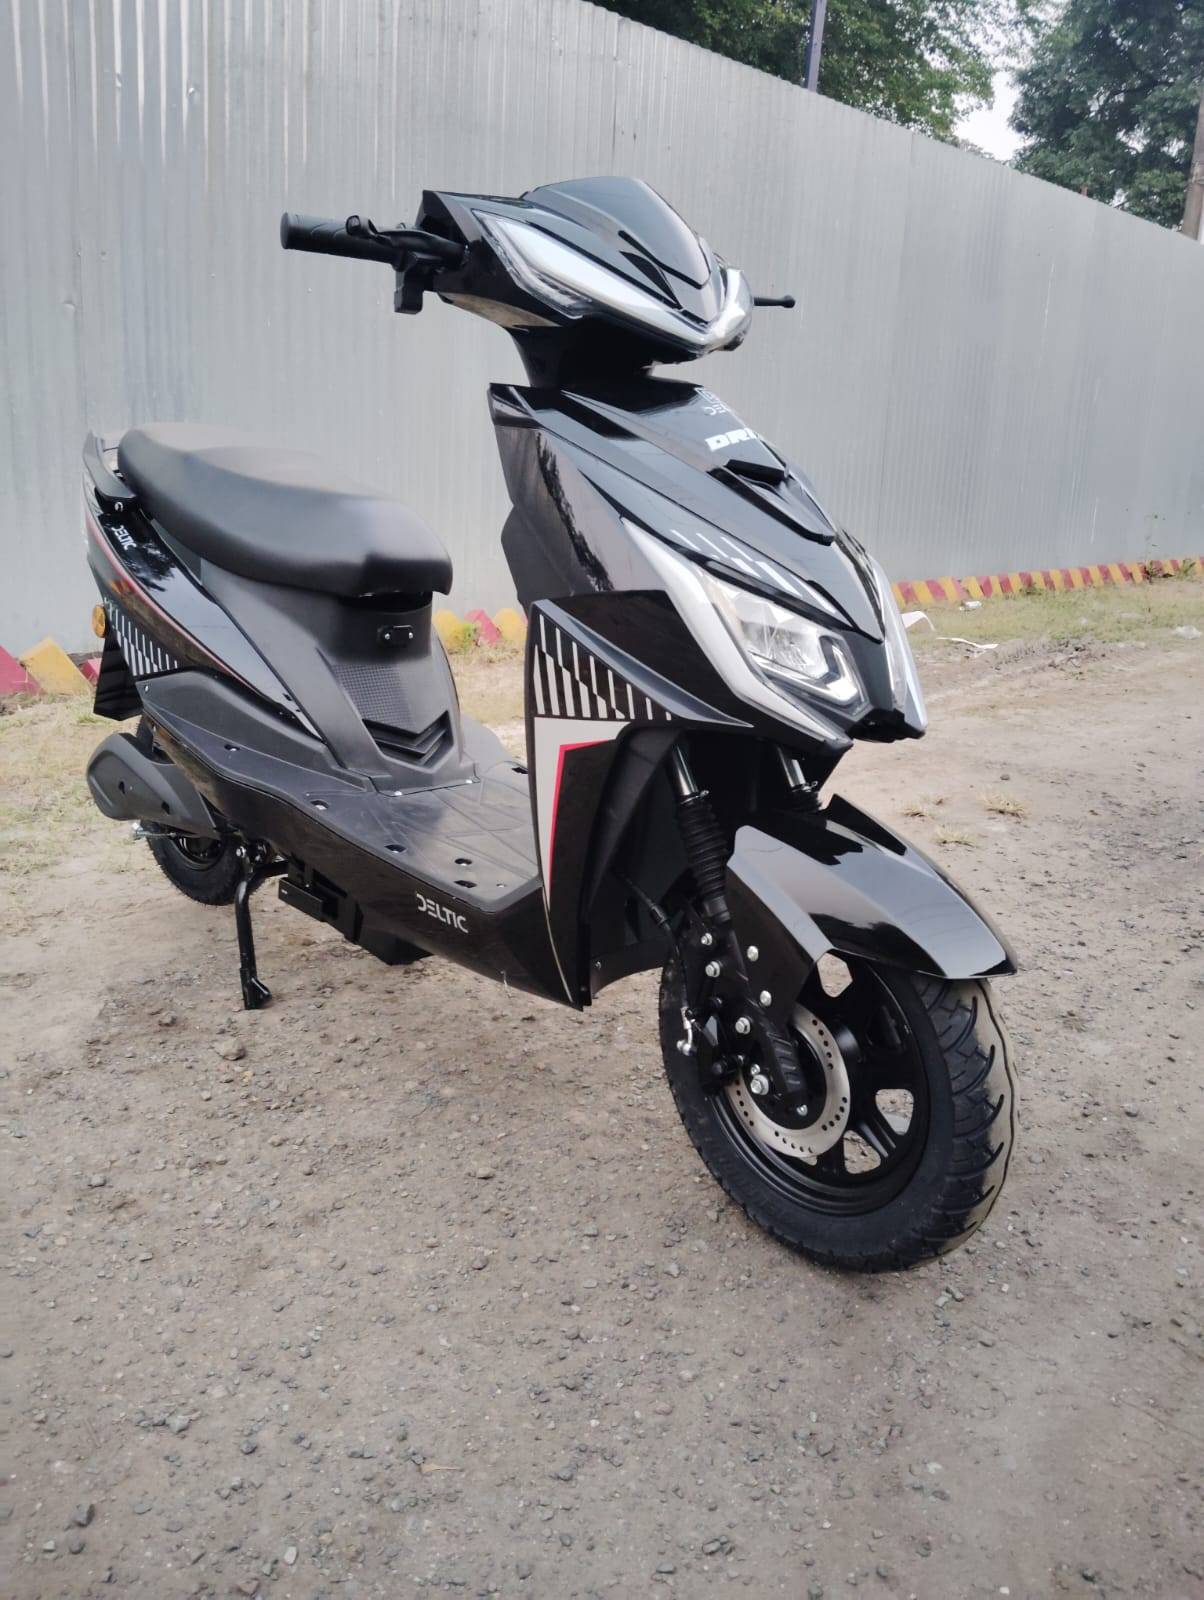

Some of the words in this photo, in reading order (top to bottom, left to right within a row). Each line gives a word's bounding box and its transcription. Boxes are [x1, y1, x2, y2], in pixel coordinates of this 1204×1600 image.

[704, 427, 759, 452] DRI
[111, 525, 137, 550] DELTIC
[416, 893, 469, 934] DELTIC
